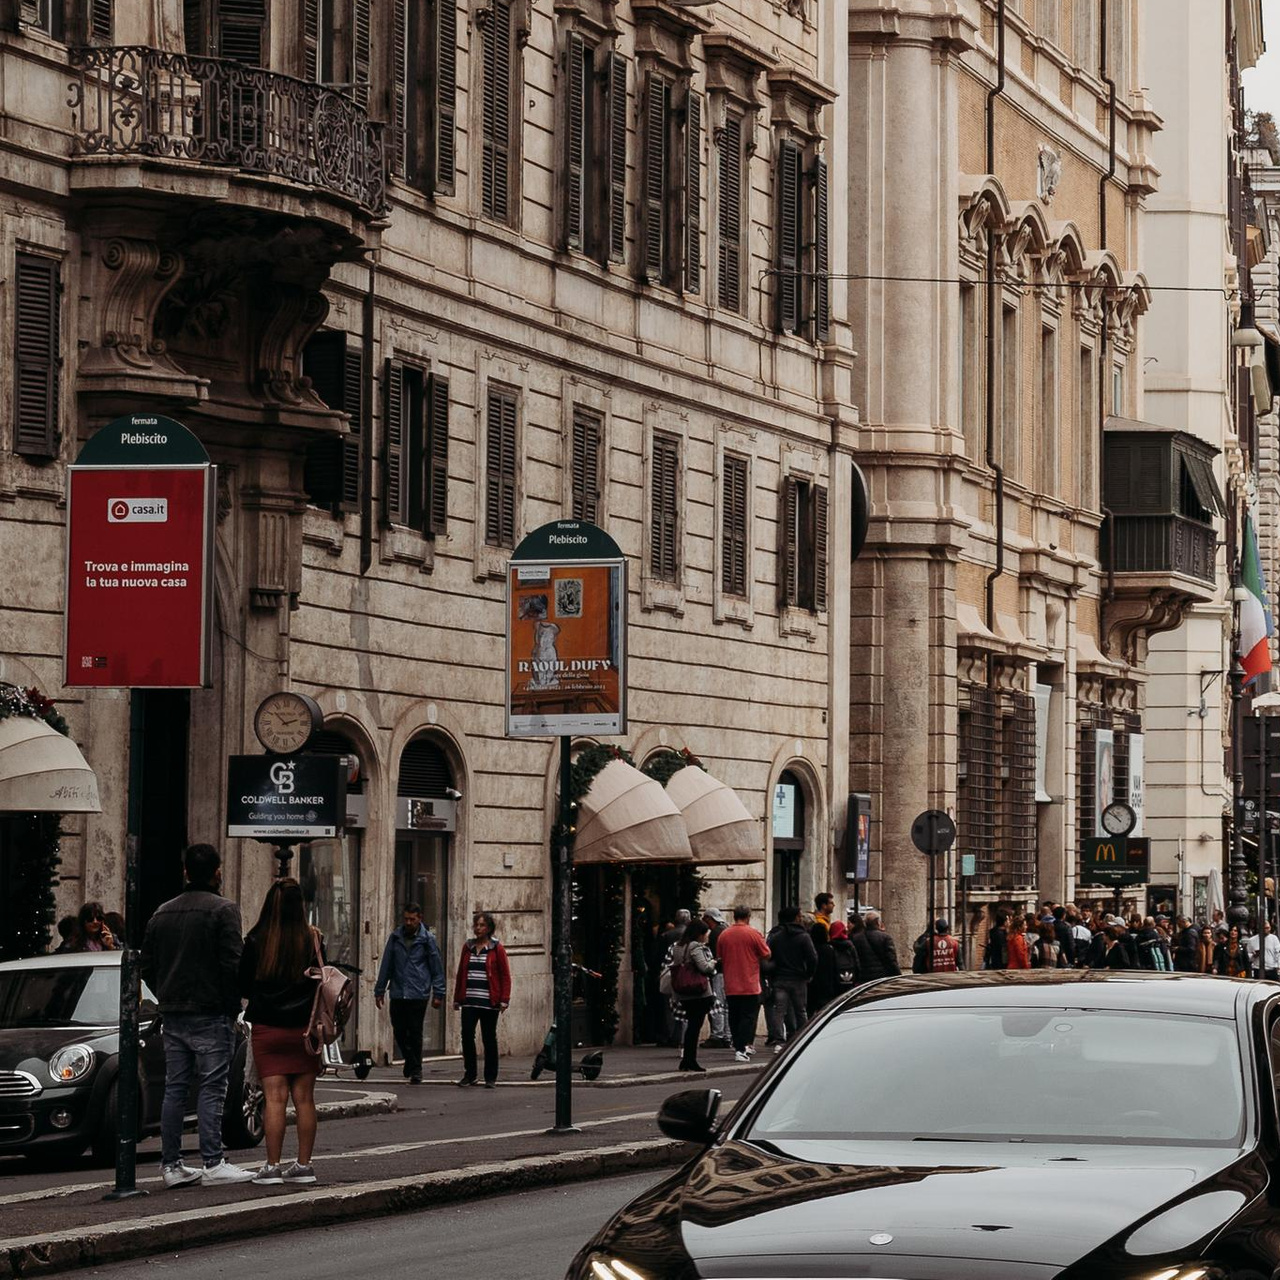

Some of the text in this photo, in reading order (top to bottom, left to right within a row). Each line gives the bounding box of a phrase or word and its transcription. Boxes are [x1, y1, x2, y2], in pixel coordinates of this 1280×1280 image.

[131, 417, 158, 425] fermata
[121, 433, 168, 444] Plebiscito
[132, 504, 165, 515] casa.it
[549, 535, 588, 544] Plebiscito
[84, 561, 189, 574] Trova e immagina
[86, 577, 187, 587] la tua nuova casa
[518, 659, 612, 673] RAOUL DUFY
[241, 795, 325, 805] COLDWELL BANKER
